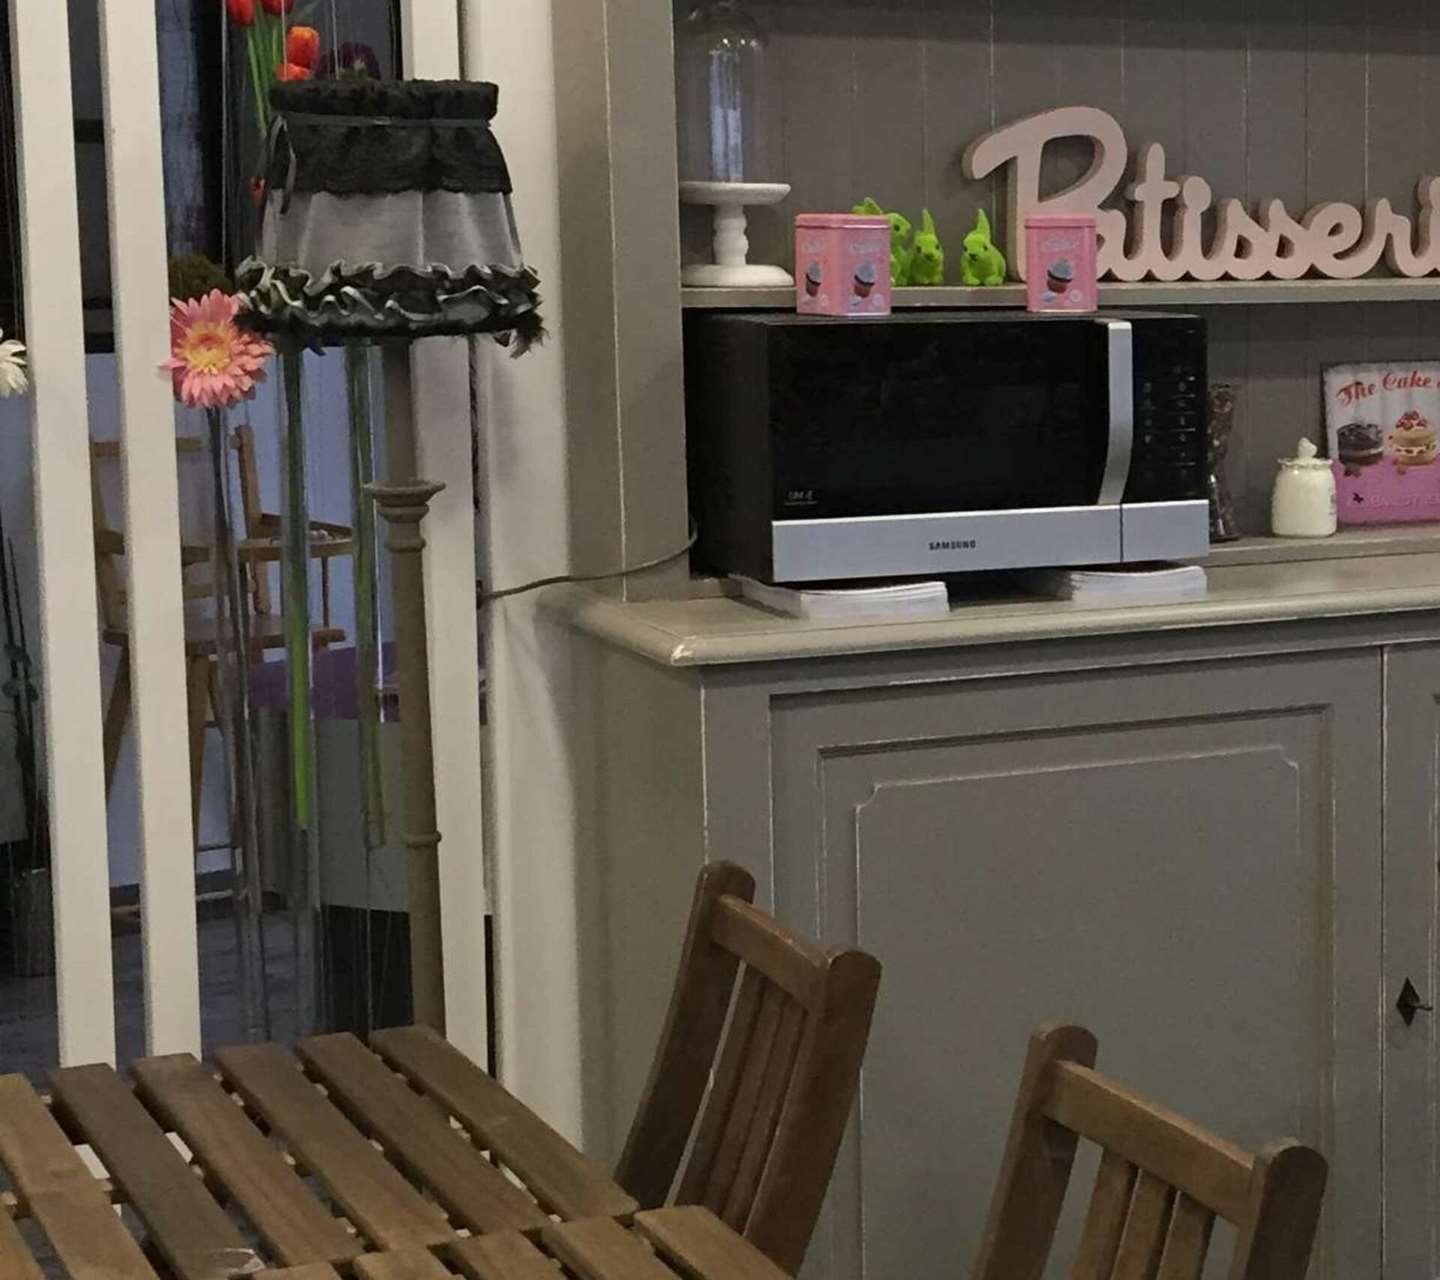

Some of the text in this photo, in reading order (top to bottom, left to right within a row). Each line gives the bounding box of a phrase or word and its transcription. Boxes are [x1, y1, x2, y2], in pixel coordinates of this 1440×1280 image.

[1336, 380, 1376, 406] The
[1382, 370, 1432, 391] Cake
[928, 540, 976, 551] SAMSUNG
